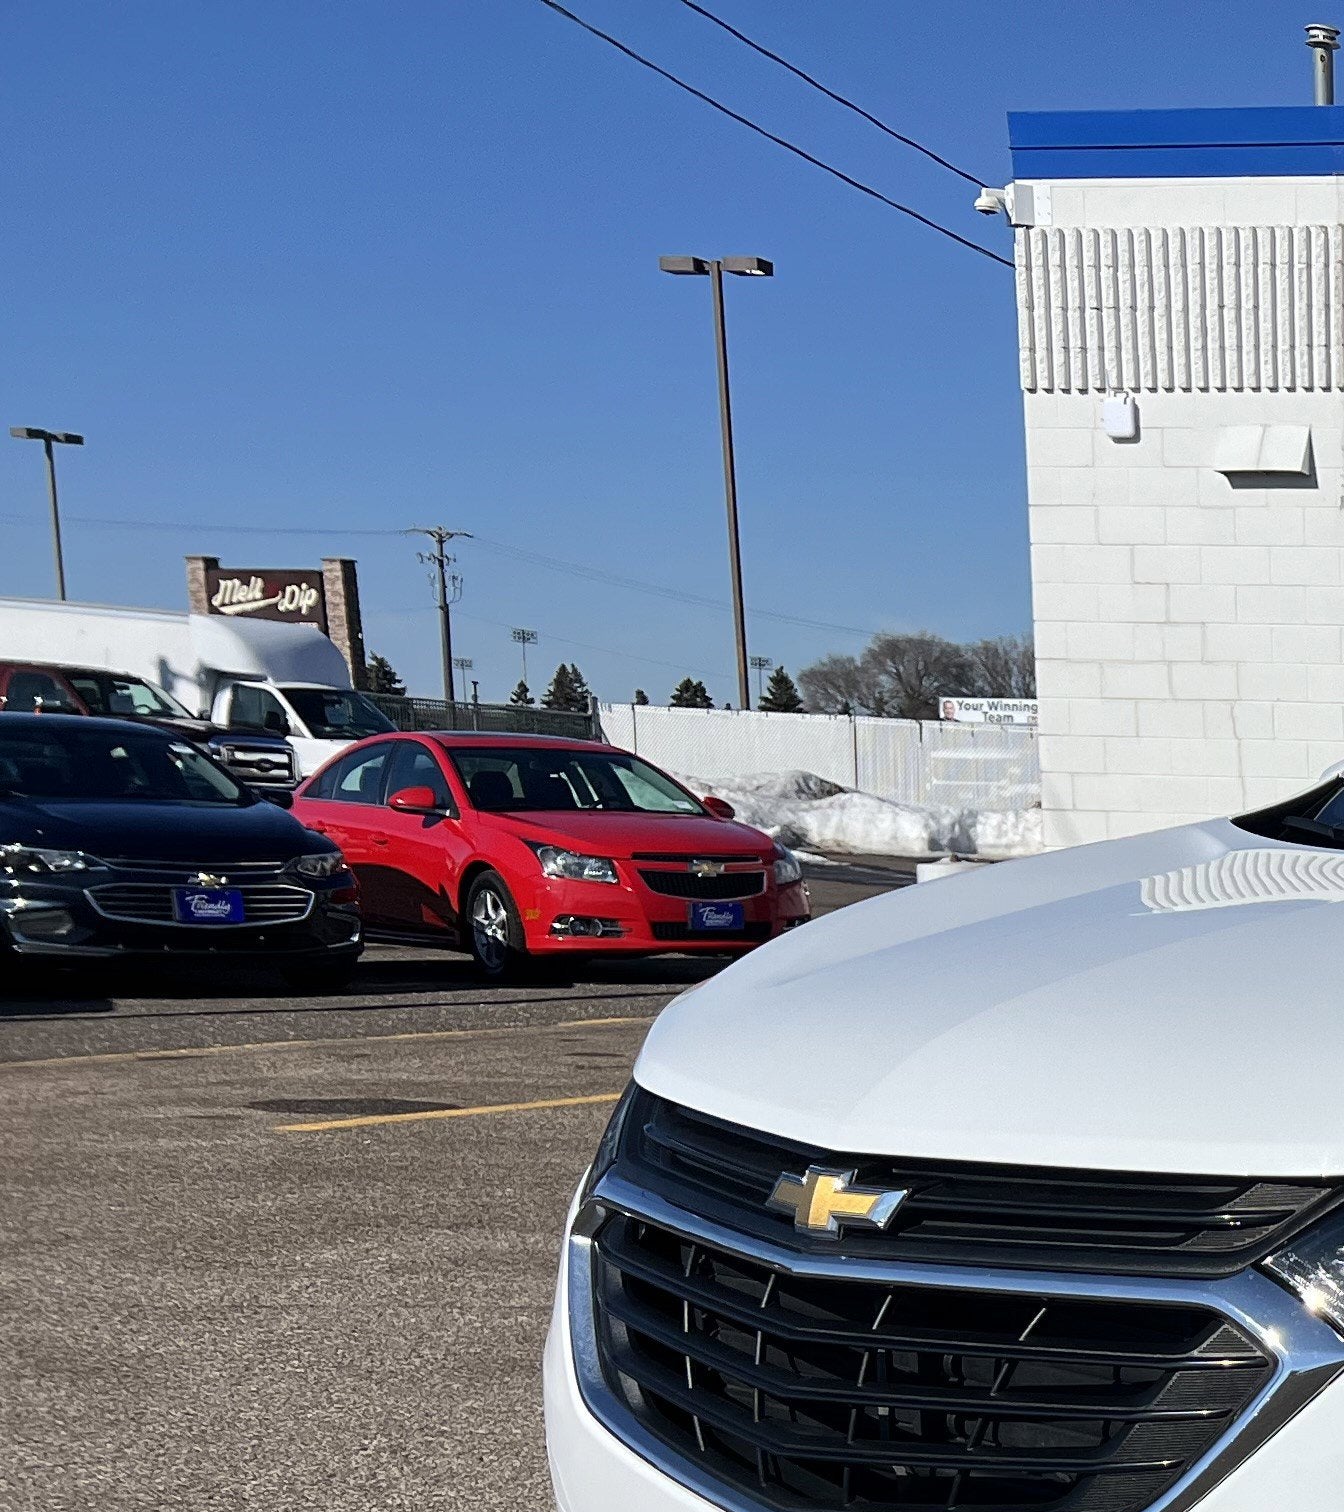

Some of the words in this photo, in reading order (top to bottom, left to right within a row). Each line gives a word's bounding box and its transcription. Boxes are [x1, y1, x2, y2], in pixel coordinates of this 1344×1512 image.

[278, 583, 319, 615] Dip
[956, 700, 984, 711] Your
[987, 700, 1038, 714] Winning
[982, 712, 1014, 723] Team
